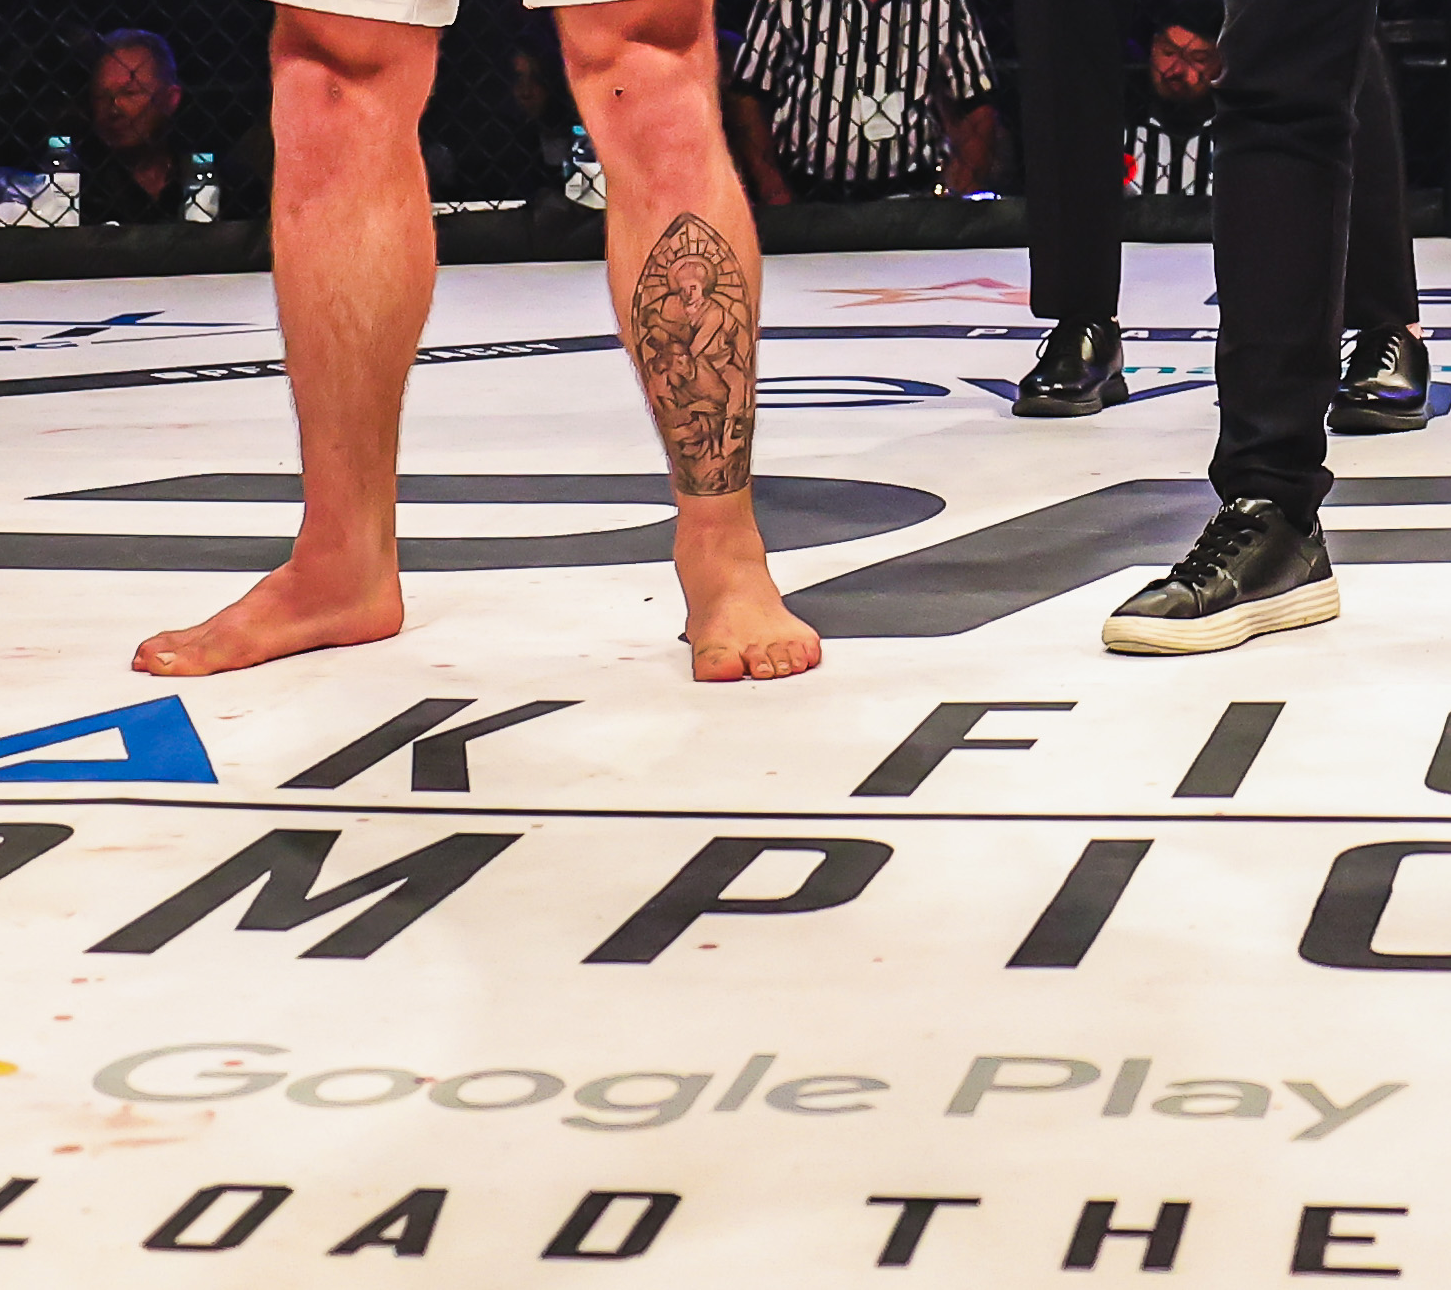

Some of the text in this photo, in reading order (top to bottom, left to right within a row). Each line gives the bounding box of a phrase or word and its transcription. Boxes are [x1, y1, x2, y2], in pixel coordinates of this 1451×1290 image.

[91, 1041, 1411, 1142] Google Play
[866, 1196, 1410, 1280] THE
